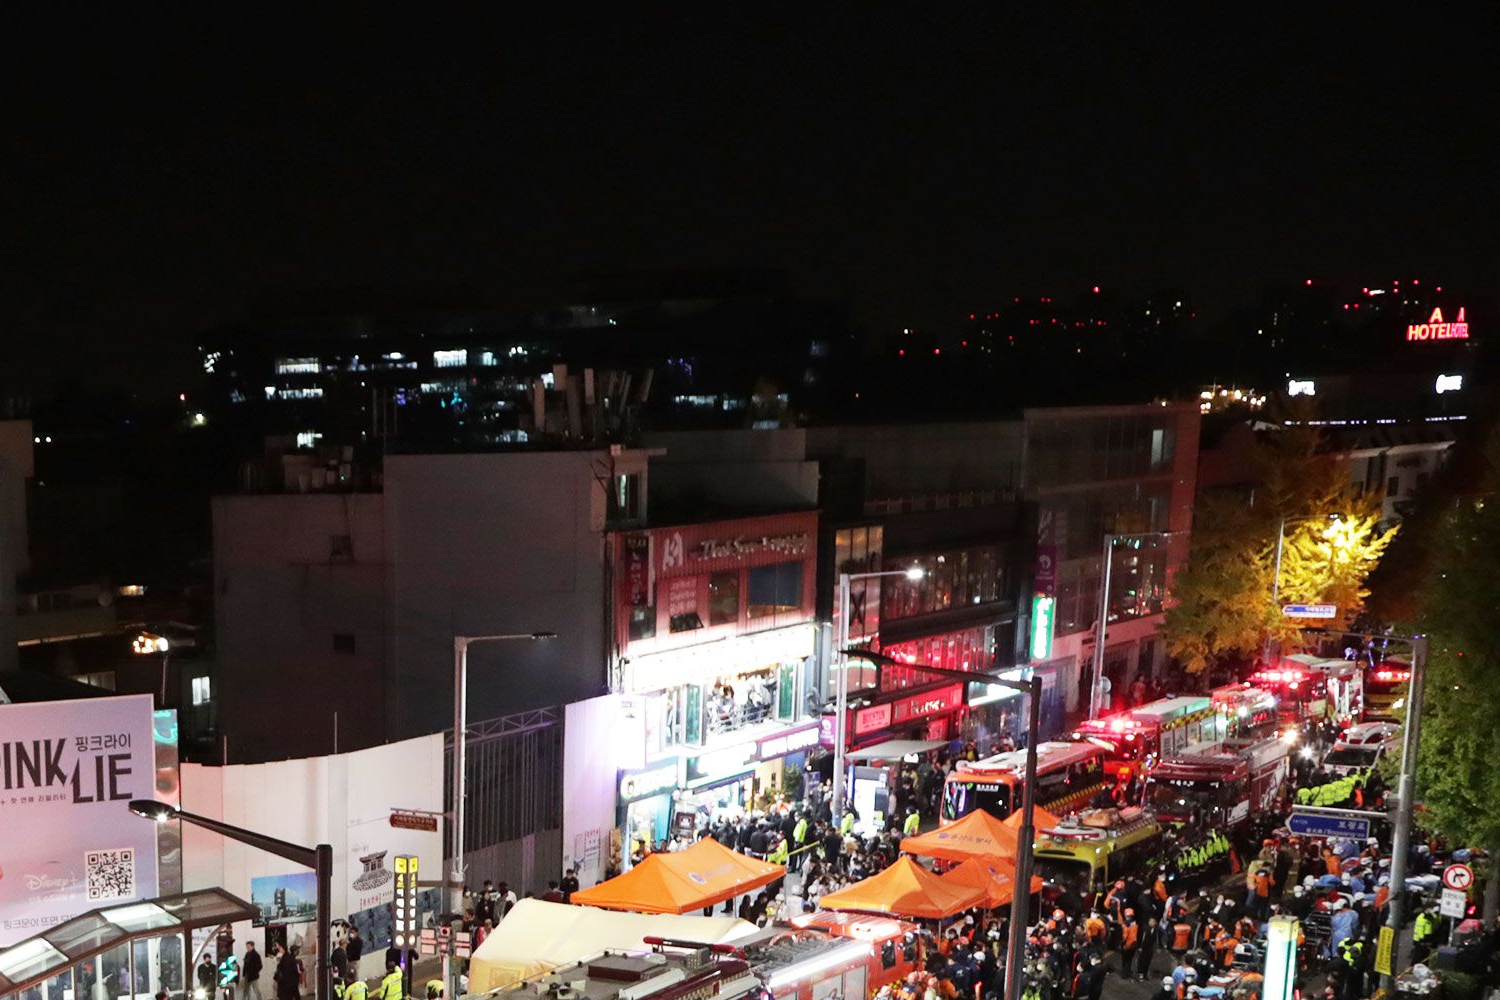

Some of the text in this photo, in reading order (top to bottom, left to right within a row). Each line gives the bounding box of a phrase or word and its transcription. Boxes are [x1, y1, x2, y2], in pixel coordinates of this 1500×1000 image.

[1430, 307, 1443, 322] A
[1408, 322, 1453, 341] HOTEL
[75, 732, 132, 752] 핑크라이
[70, 752, 133, 804] LIE
[24, 871, 79, 892] Disney+
